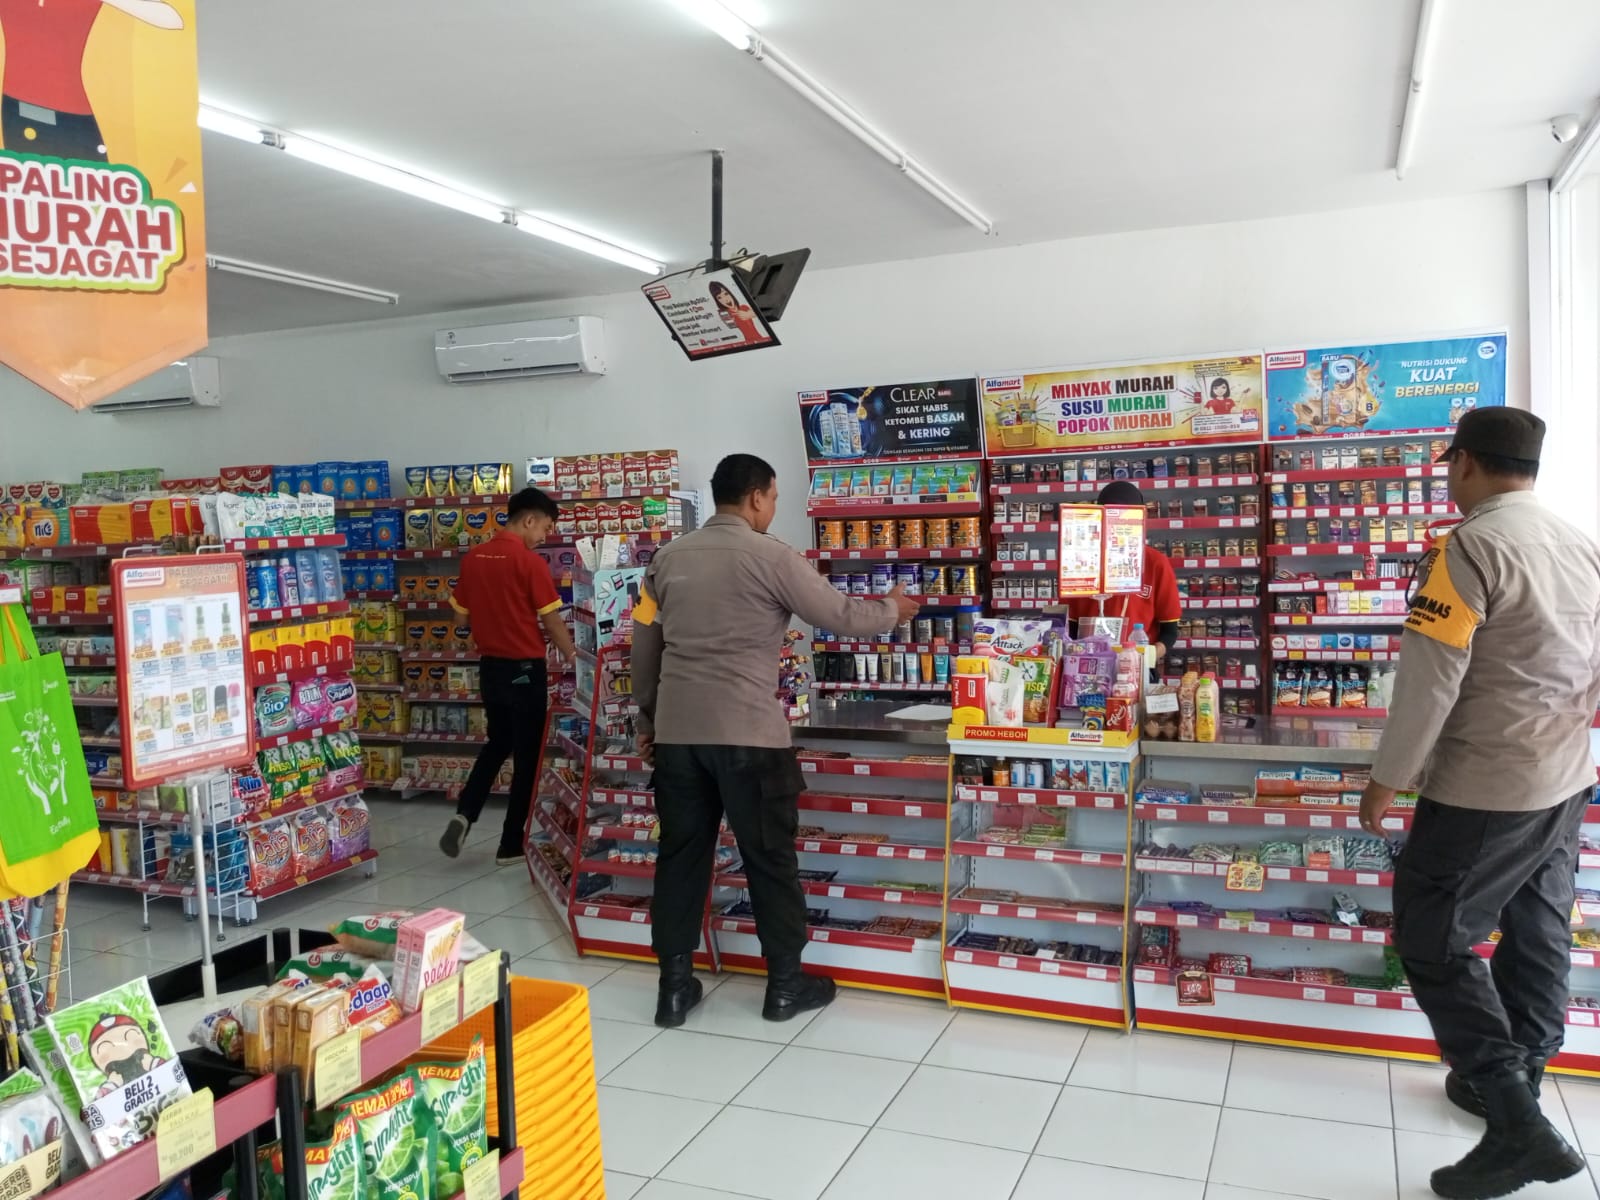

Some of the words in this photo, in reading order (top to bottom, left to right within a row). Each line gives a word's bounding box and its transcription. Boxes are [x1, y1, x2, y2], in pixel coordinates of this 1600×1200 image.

[0, 163, 138, 205] PALING
[0, 197, 172, 251] URAH
[1269, 354, 1302, 363] Alfamart
[1401, 360, 1433, 368] NUTRISI
[1434, 357, 1467, 365] DUKUNG
[1410, 367, 1456, 382] KUAT
[986, 378, 1021, 387] Alfamart
[1051, 381, 1112, 399] MINYAK
[1116, 375, 1175, 394] MURAH
[1395, 382, 1480, 398] BERENERGI
[890, 387, 936, 403] CLEAR
[895, 405, 921, 414] SIKAT
[922, 403, 949, 413] HABIS
[1061, 400, 1104, 417] SUSU
[1108, 394, 1166, 412] MURAH
[884, 417, 925, 426] KETOMBE
[926, 412, 965, 424] BASAH
[1057, 417, 1110, 434] POPOK
[1113, 412, 1172, 430] MURAH
[897, 429, 906, 440] &
[909, 427, 951, 439] KERING
[127, 570, 161, 578] Alfamart
[991, 636, 1024, 649] Attack
[1024, 682, 1044, 692] nso
[966, 729, 996, 737] PROMO
[998, 730, 1027, 738] HEBOH
[1070, 731, 1102, 739] Alfamart
[350, 982, 391, 1010] daap
[124, 1079, 145, 1100] BELI
[146, 1075, 153, 1088] 2
[124, 1088, 154, 1112] GRATIS
[154, 1085, 161, 1096] 1
[364, 1099, 414, 1176] Sunlight
